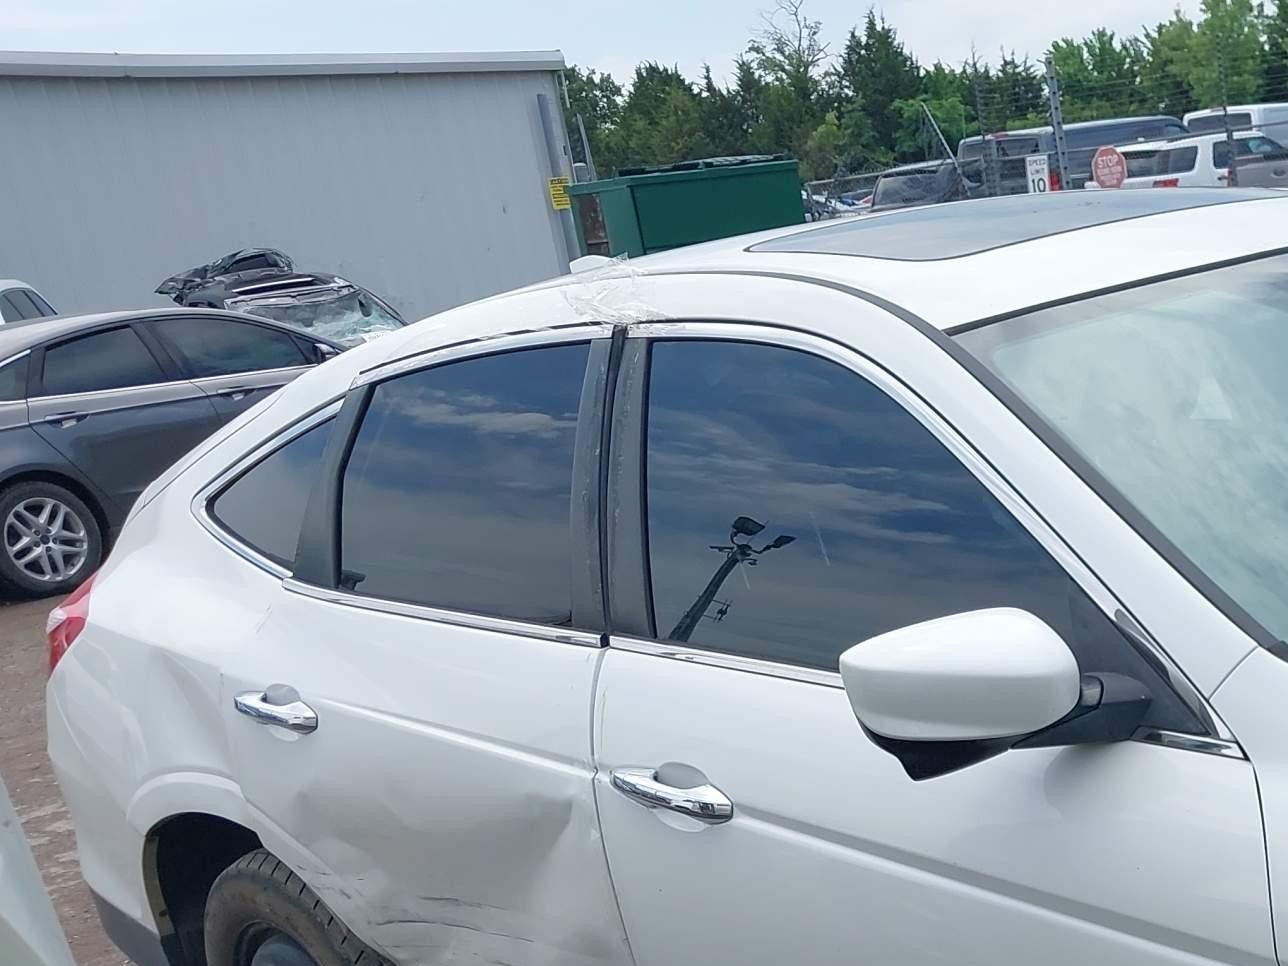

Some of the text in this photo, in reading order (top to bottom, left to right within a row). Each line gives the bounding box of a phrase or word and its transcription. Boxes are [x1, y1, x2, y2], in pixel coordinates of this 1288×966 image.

[1028, 158, 1046, 166] SPEED
[1097, 154, 1118, 168] STOP
[1030, 167, 1045, 176] LIMIT
[1031, 177, 1047, 193] 10
